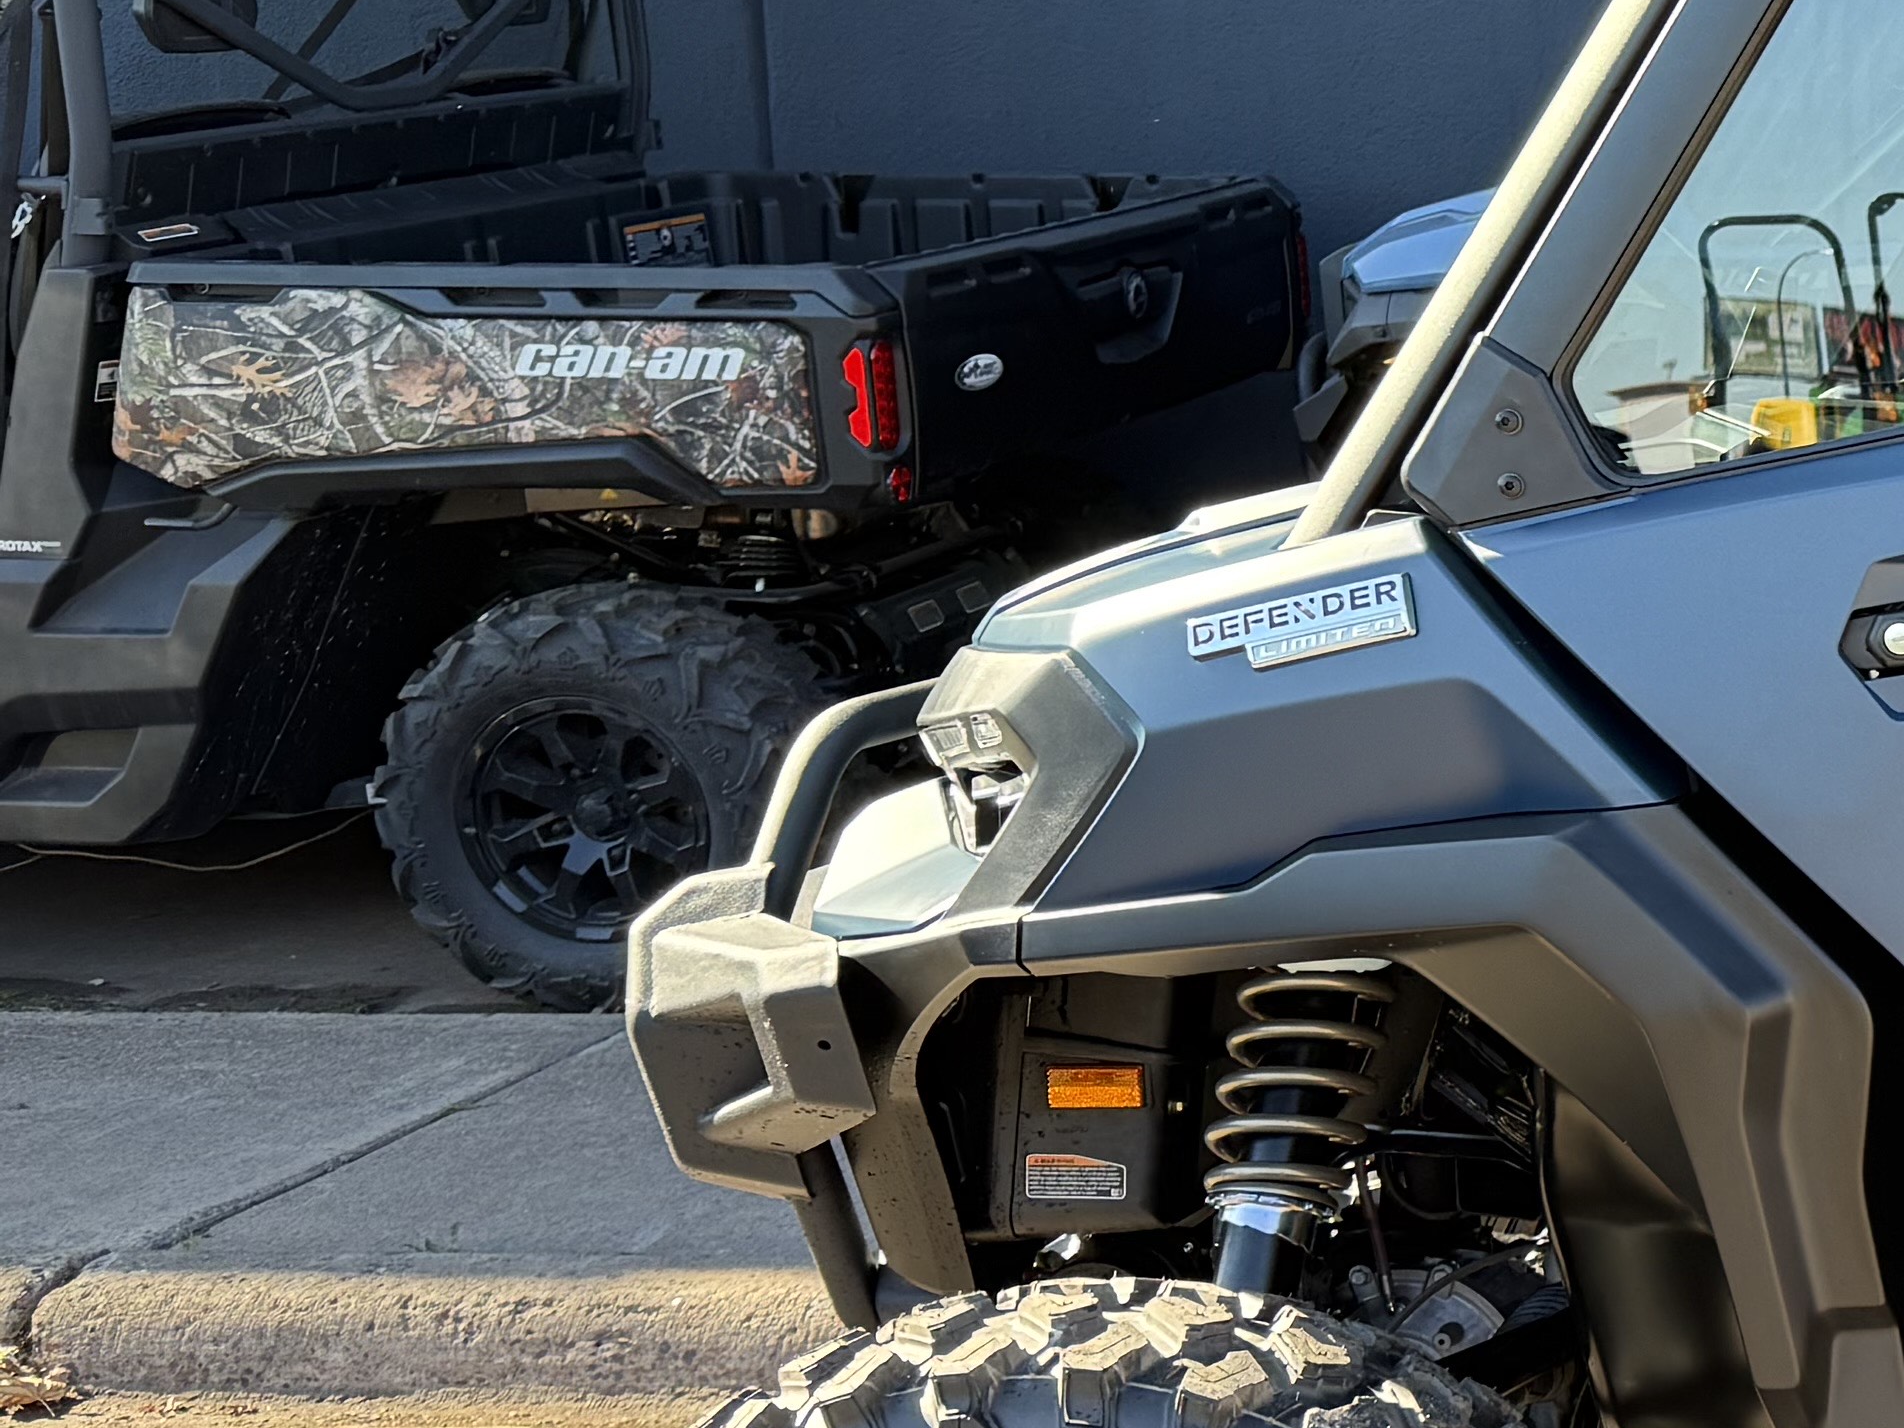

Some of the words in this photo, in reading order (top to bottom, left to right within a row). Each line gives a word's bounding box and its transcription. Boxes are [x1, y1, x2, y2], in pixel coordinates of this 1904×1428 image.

[515, 343, 745, 380] can-am
[0, 540, 42, 552] ROTAX
[1193, 580, 1397, 647] DEFENDER
[1259, 615, 1396, 657] LIMITED
